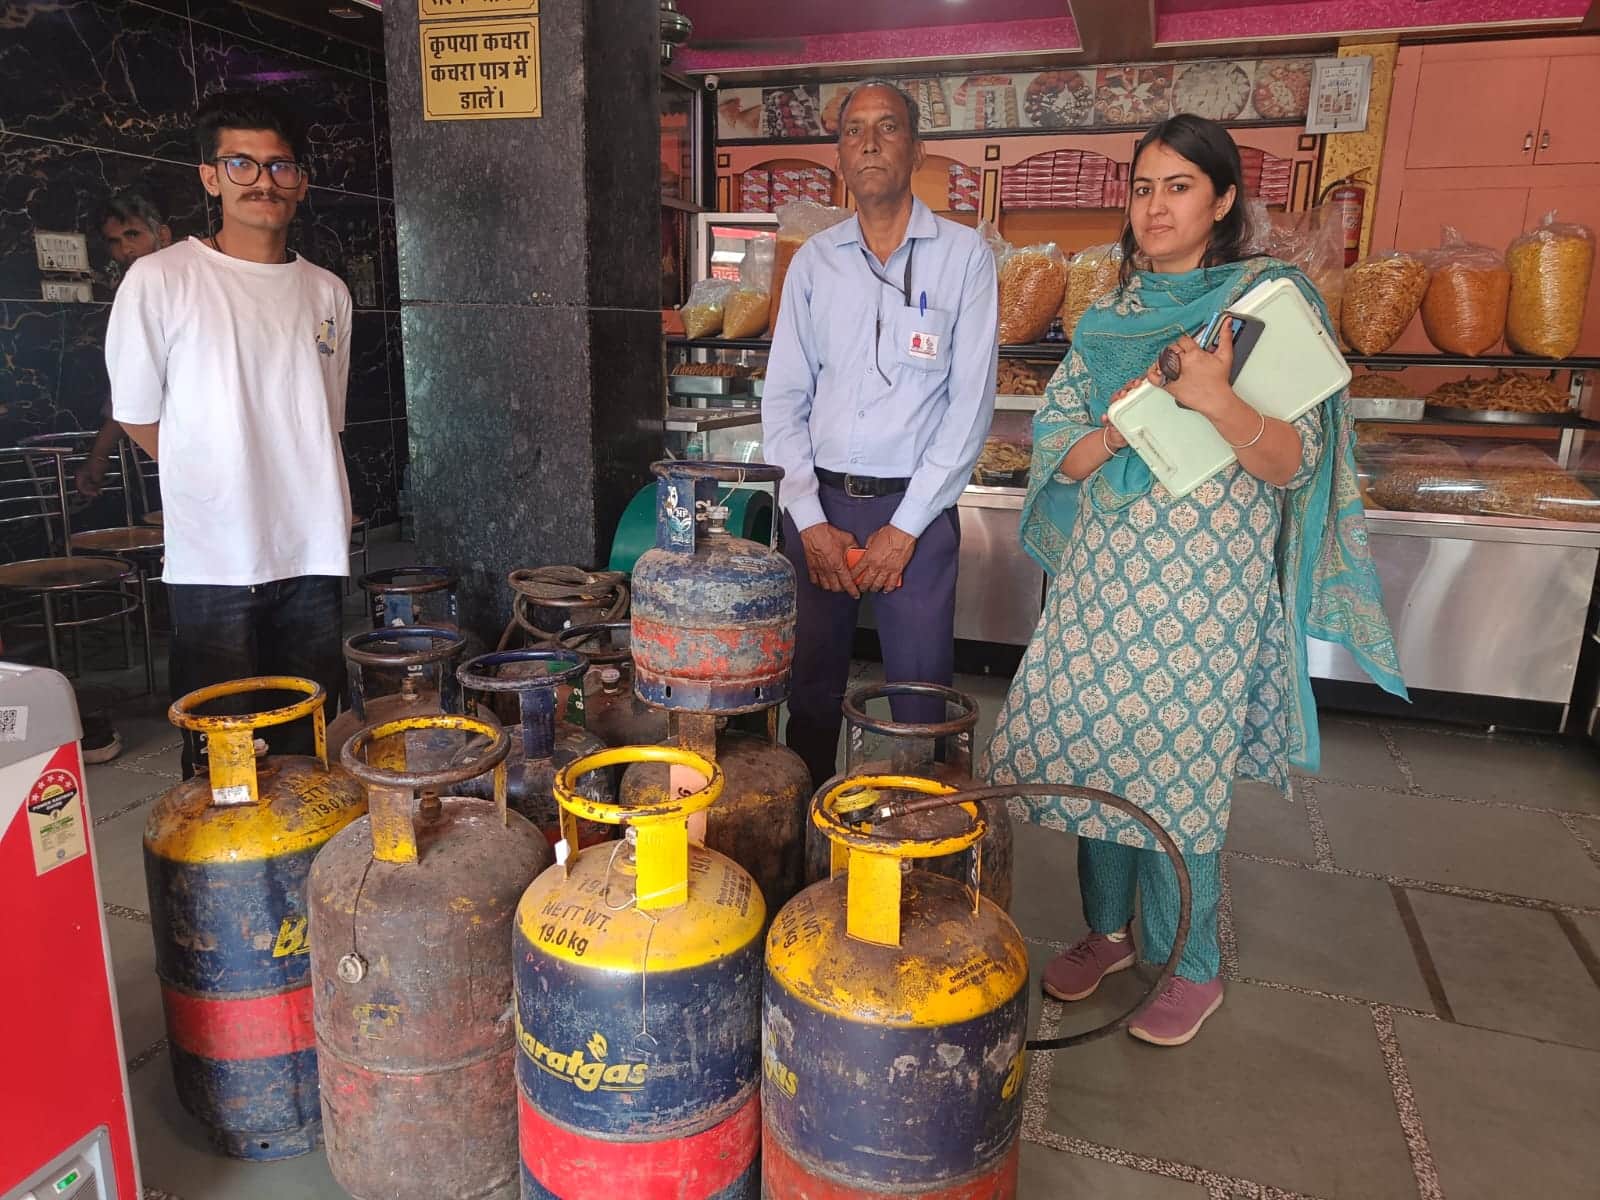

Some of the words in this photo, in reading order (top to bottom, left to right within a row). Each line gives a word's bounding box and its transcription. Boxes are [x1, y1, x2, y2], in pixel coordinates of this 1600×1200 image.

[428, 34, 478, 59] कृपया
[482, 31, 530, 51] कचरा
[429, 63, 476, 82] कचरा
[478, 61, 510, 80] पात्र
[513, 55, 531, 78] में
[541, 901, 585, 921] NETT
[582, 909, 611, 932] WT.
[538, 923, 568, 946] 19.0
[567, 930, 589, 957] kg
